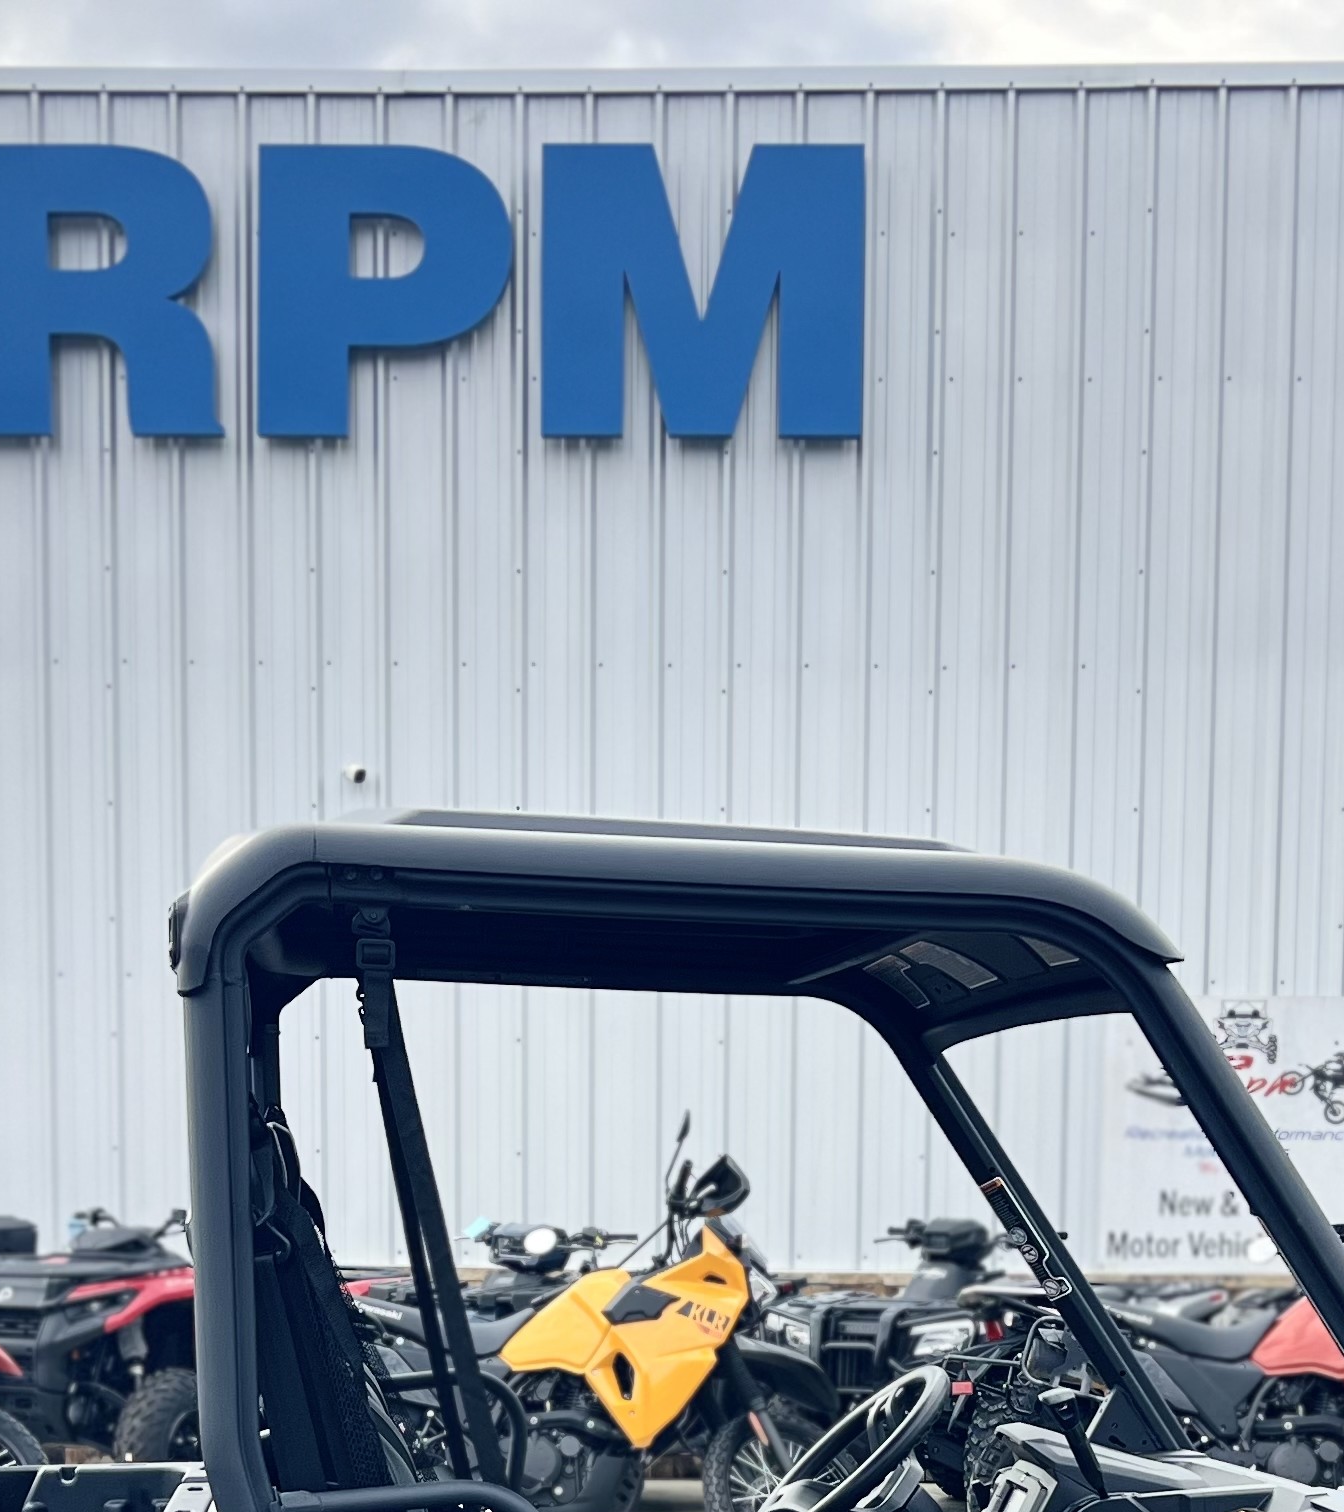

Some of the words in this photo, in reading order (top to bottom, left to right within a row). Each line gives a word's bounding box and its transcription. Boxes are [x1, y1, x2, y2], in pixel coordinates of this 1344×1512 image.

[1159, 1189, 1213, 1217] New
[1220, 1190, 1239, 1217] &
[1107, 1231, 1181, 1260] Motor
